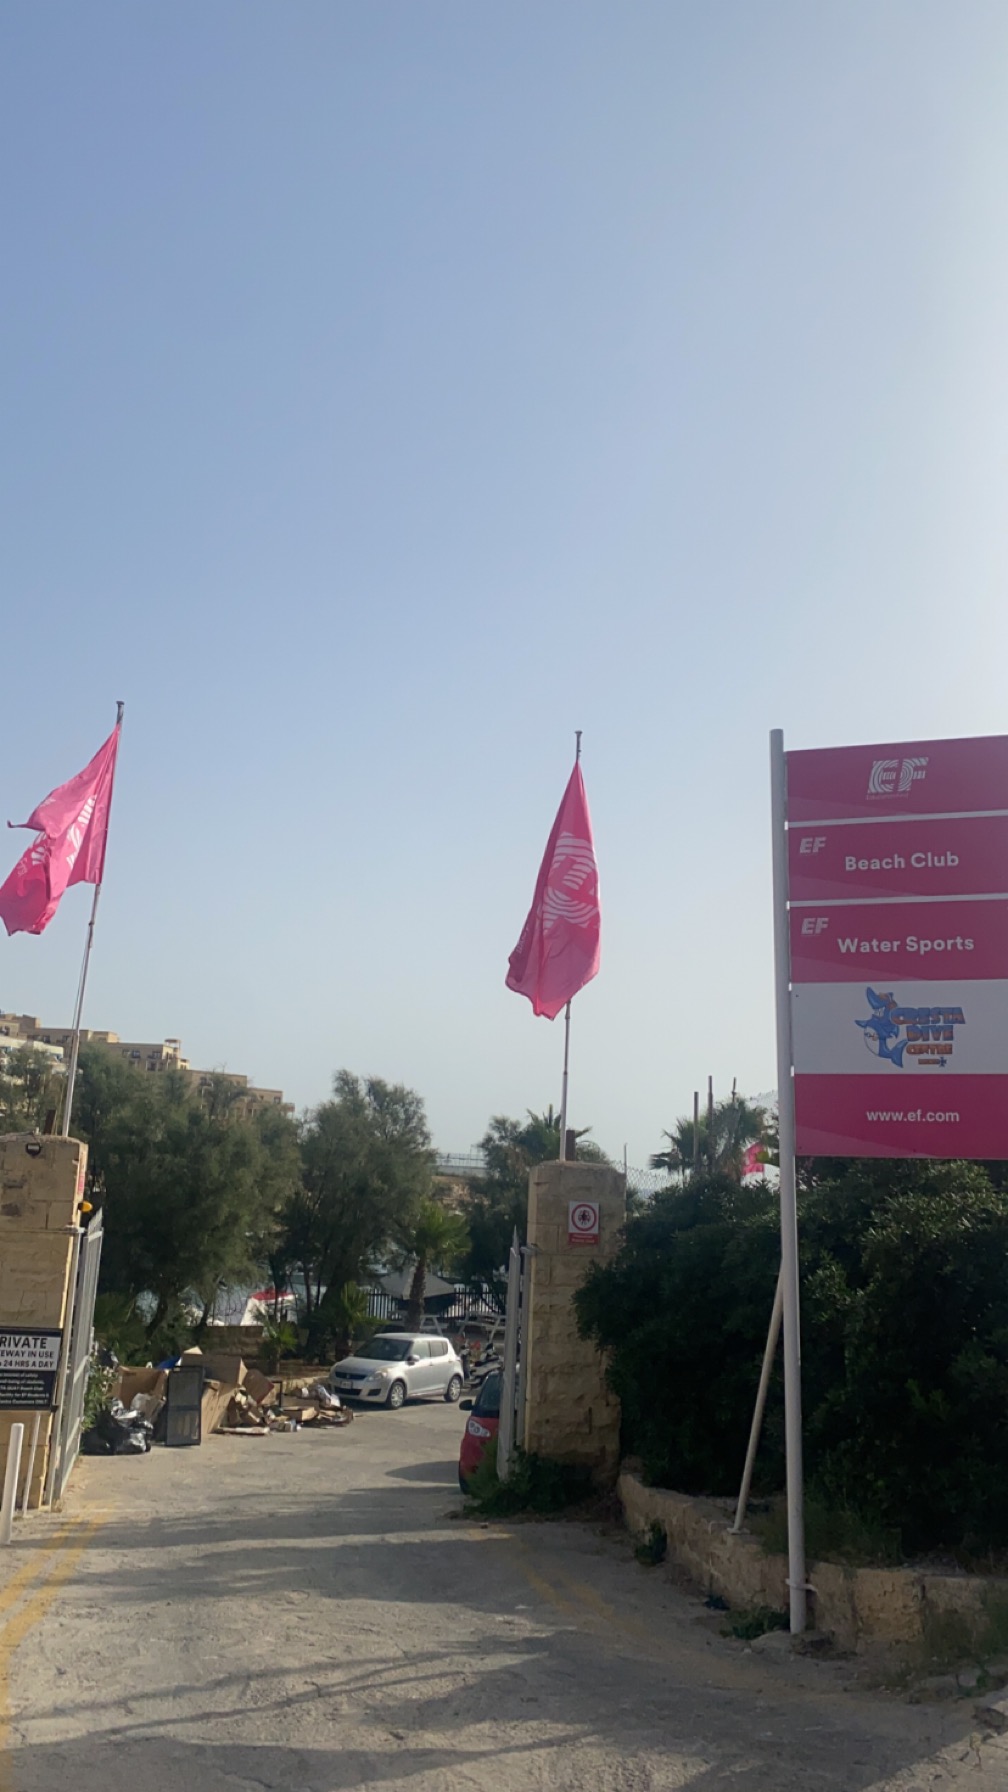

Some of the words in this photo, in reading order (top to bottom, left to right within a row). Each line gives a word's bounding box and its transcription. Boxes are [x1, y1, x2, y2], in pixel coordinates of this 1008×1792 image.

[867, 756, 929, 794] EF
[799, 836, 827, 854] EF
[845, 854, 906, 871] Beach
[910, 851, 960, 868] Club
[801, 917, 829, 935] EF
[837, 938, 901, 954] Water
[905, 935, 975, 956] Sports
[906, 1025, 954, 1041] DIVE
[866, 1110, 960, 1122] www.ef.com
[27, 1350, 36, 1358] IN
[38, 1351, 55, 1359] USE
[14, 1360, 30, 1368] HRS
